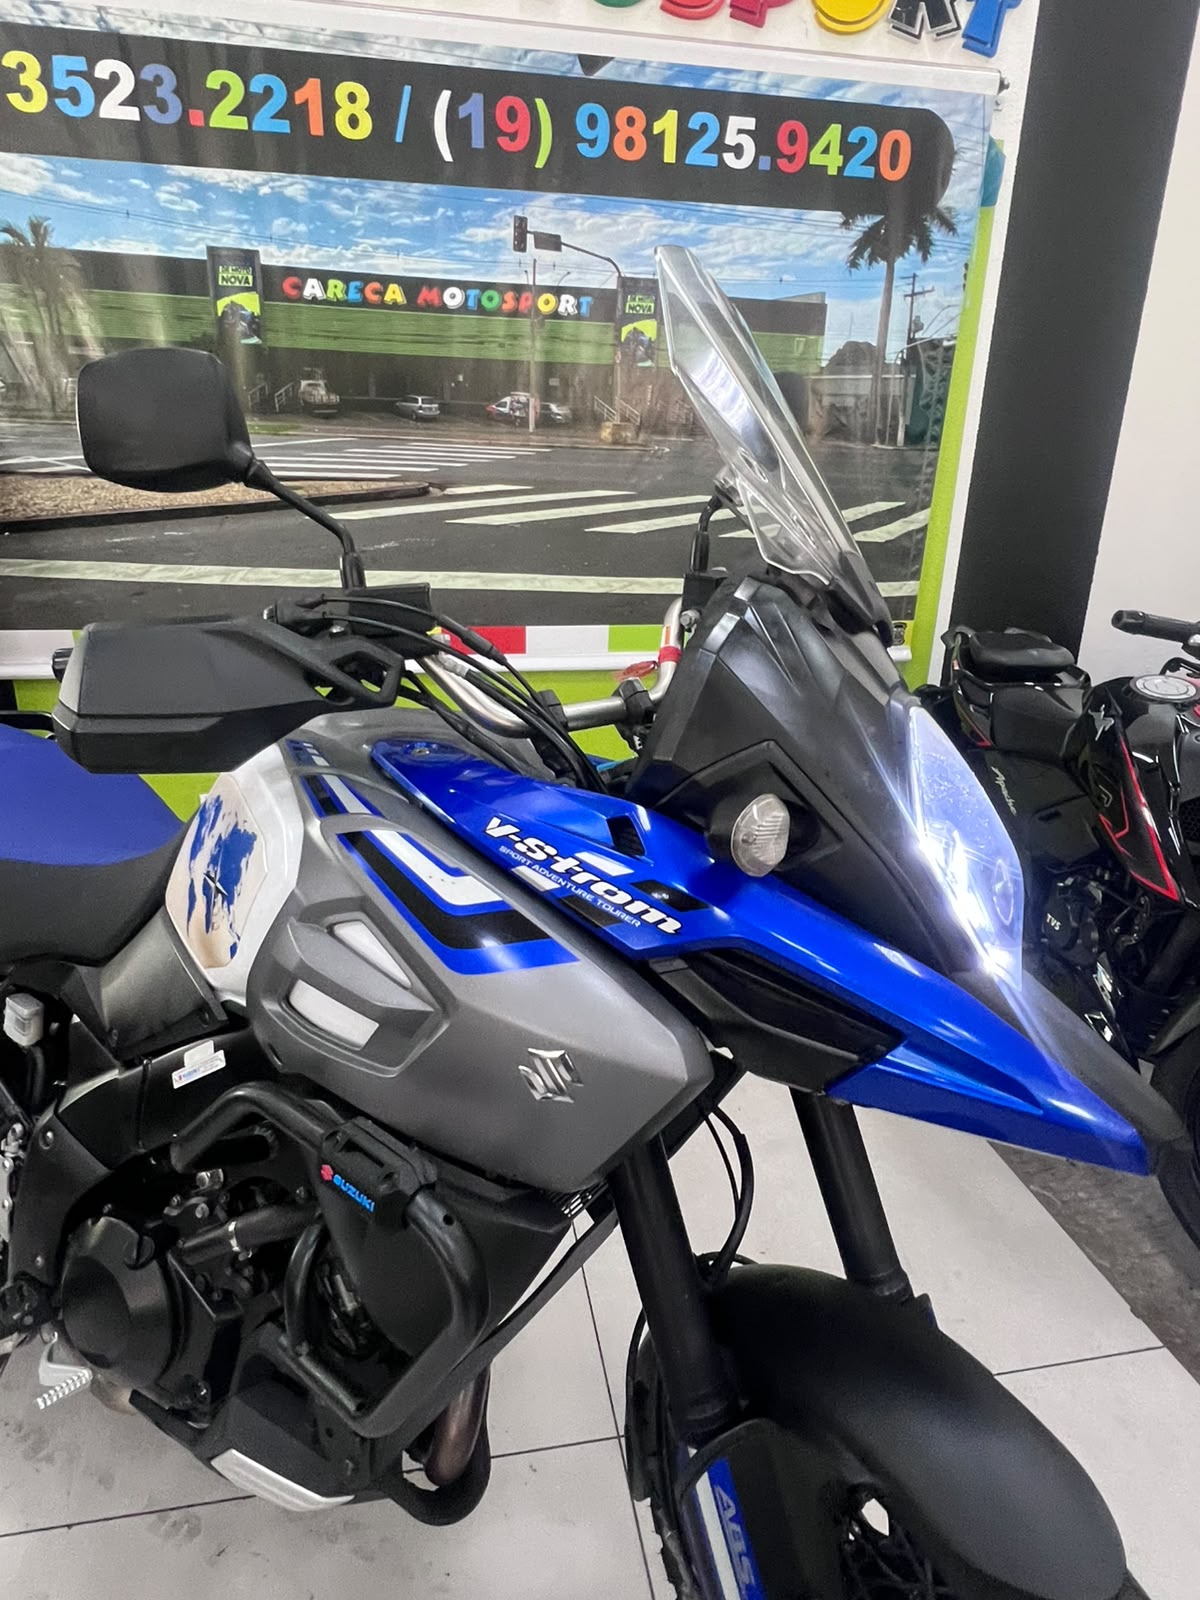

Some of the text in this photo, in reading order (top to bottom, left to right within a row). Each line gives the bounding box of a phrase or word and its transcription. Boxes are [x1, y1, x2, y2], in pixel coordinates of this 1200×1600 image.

[1, 50, 912, 182] 3523.2218 / (19) 98125.9420
[220, 274, 251, 286] NOVA
[281, 275, 593, 317] CARECA MOTOSPORT
[499, 844, 641, 928] SPORT ADVENTURE TOURER
[1046, 912, 1061, 931] TVS
[332, 1174, 376, 1213] SUZUKI
[713, 1485, 757, 1588] ABS
